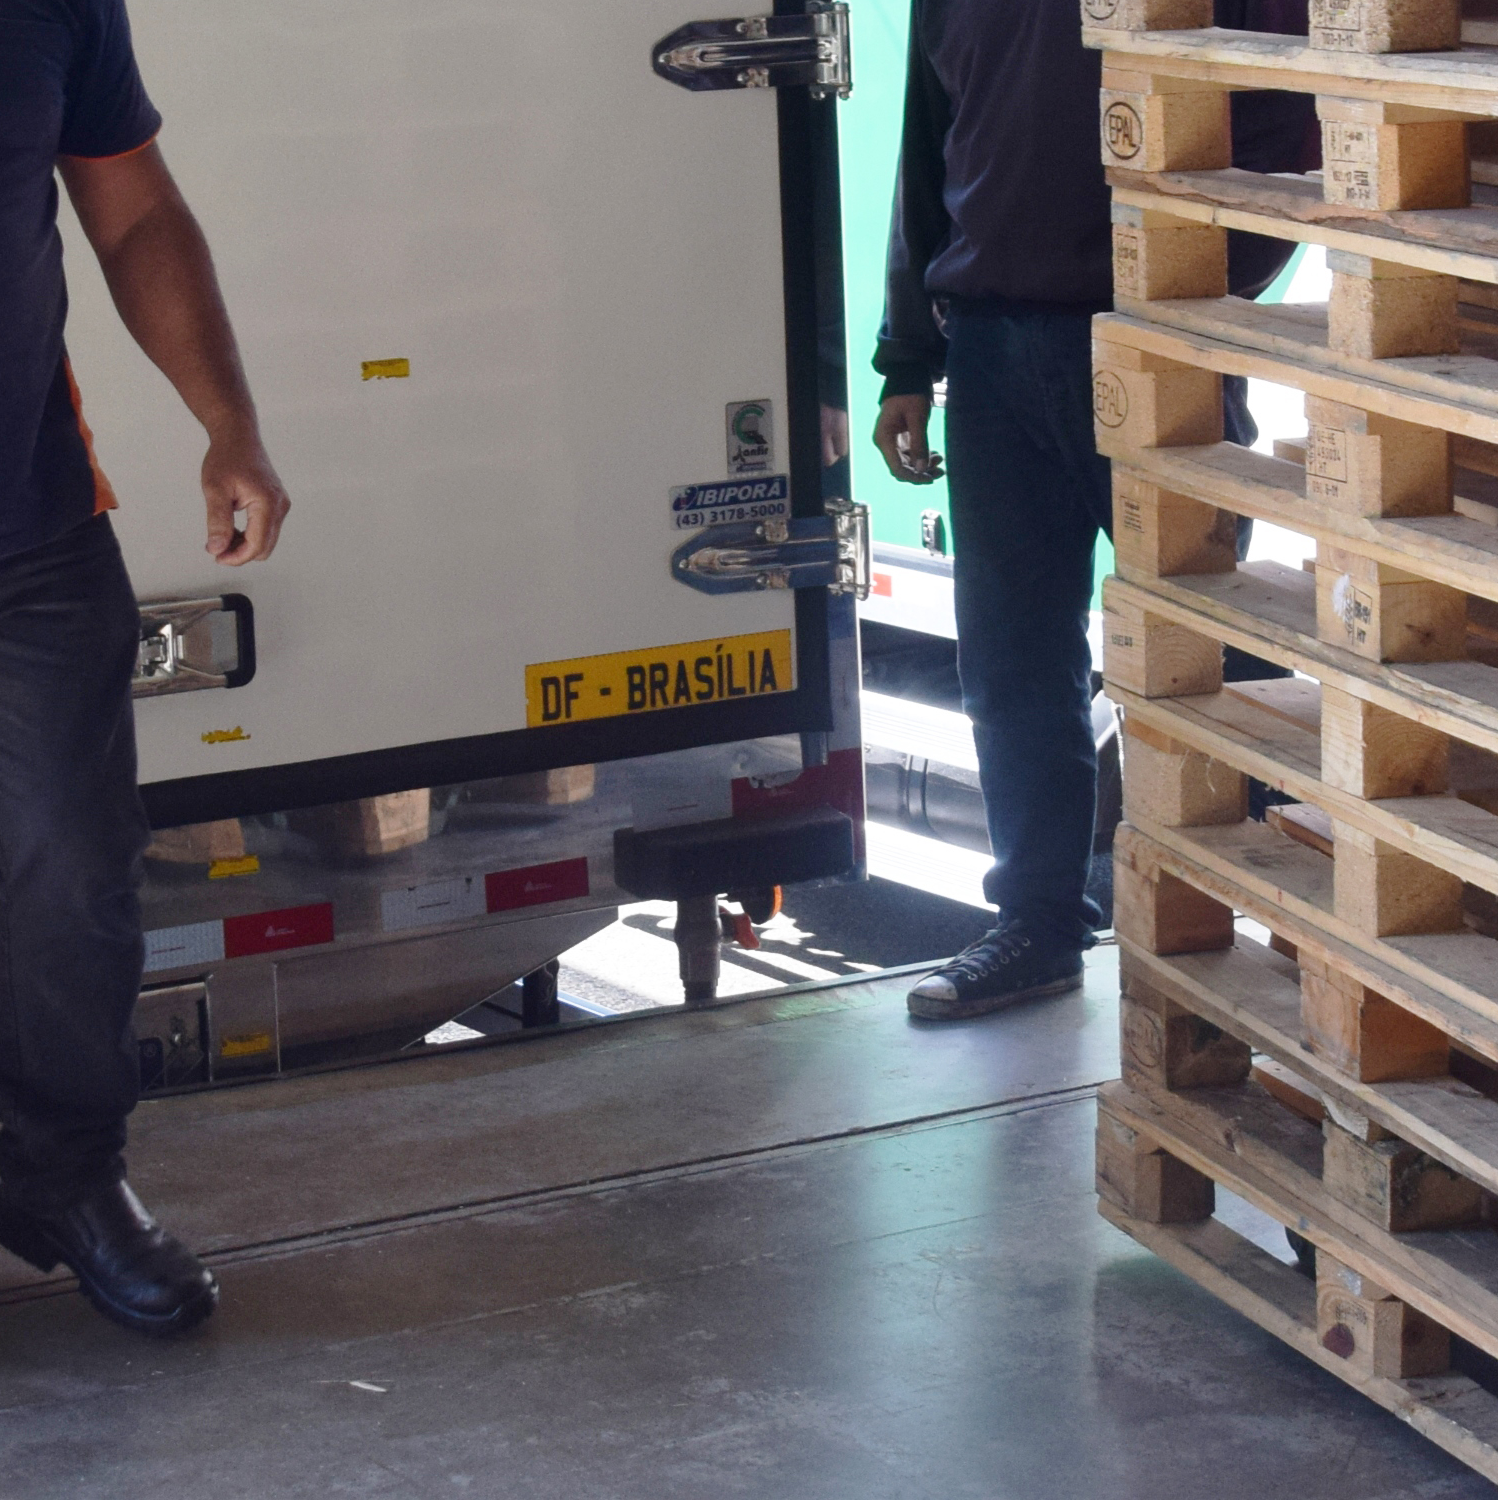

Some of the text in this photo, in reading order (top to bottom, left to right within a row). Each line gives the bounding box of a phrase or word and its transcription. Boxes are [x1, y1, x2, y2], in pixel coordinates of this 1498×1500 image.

[1108, 113, 1138, 149] EPAL
[695, 478, 782, 506] IBIPORÃ
[676, 502, 786, 529] (43) 3178-5000
[541, 672, 584, 722] DF
[626, 643, 778, 711] BRASÍLIA
